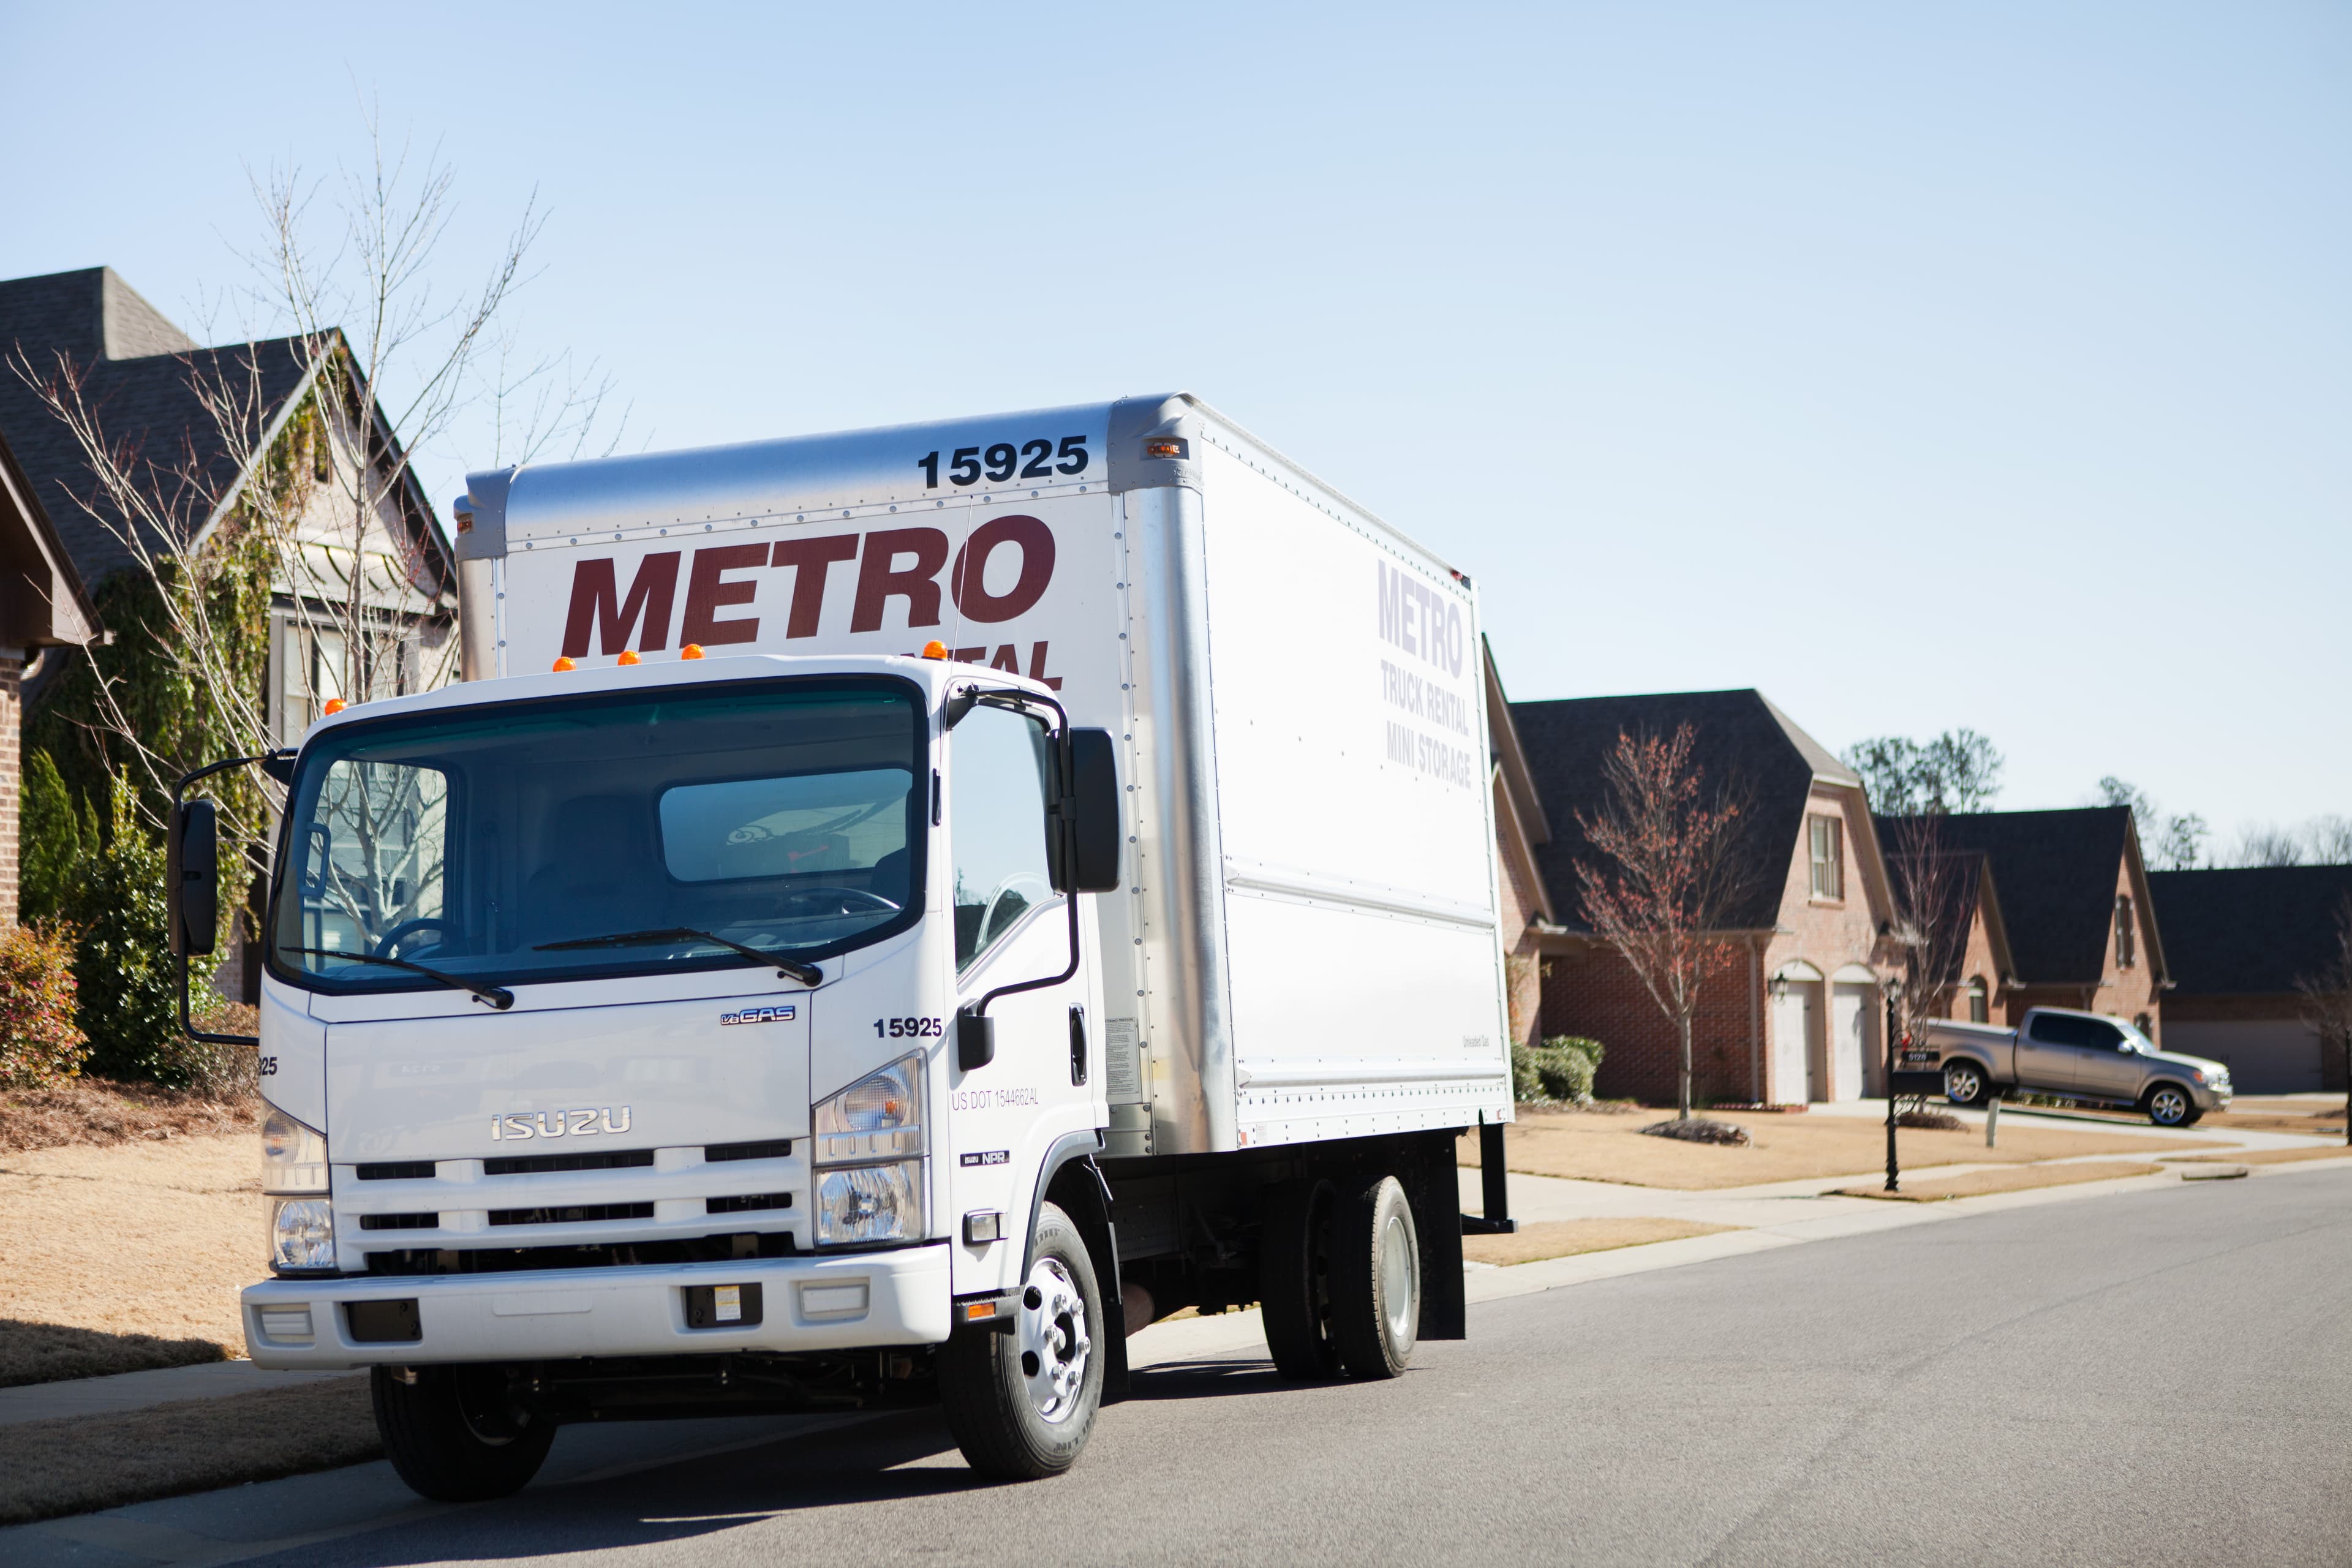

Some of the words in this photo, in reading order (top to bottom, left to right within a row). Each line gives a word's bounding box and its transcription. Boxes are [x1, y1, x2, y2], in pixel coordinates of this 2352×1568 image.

[918, 435, 1088, 489] 15925
[562, 514, 1056, 658] METRO
[1378, 559, 1463, 679] METRO
[1381, 658, 1424, 717] TRUCK
[1427, 682, 1469, 737] RENTAL
[1387, 720, 1414, 768] MINI
[1419, 733, 1471, 790] STORAGE
[739, 1006, 794, 1023] GAS
[873, 1017, 942, 1038] 15925
[952, 1092, 968, 1110] US
[971, 1090, 992, 1109] DOT
[995, 1087, 1038, 1107] 1544662AL
[492, 1106, 631, 1141] ISUZU
[965, 1156, 979, 1164] ISUZU
[982, 1151, 1005, 1165] NPR
